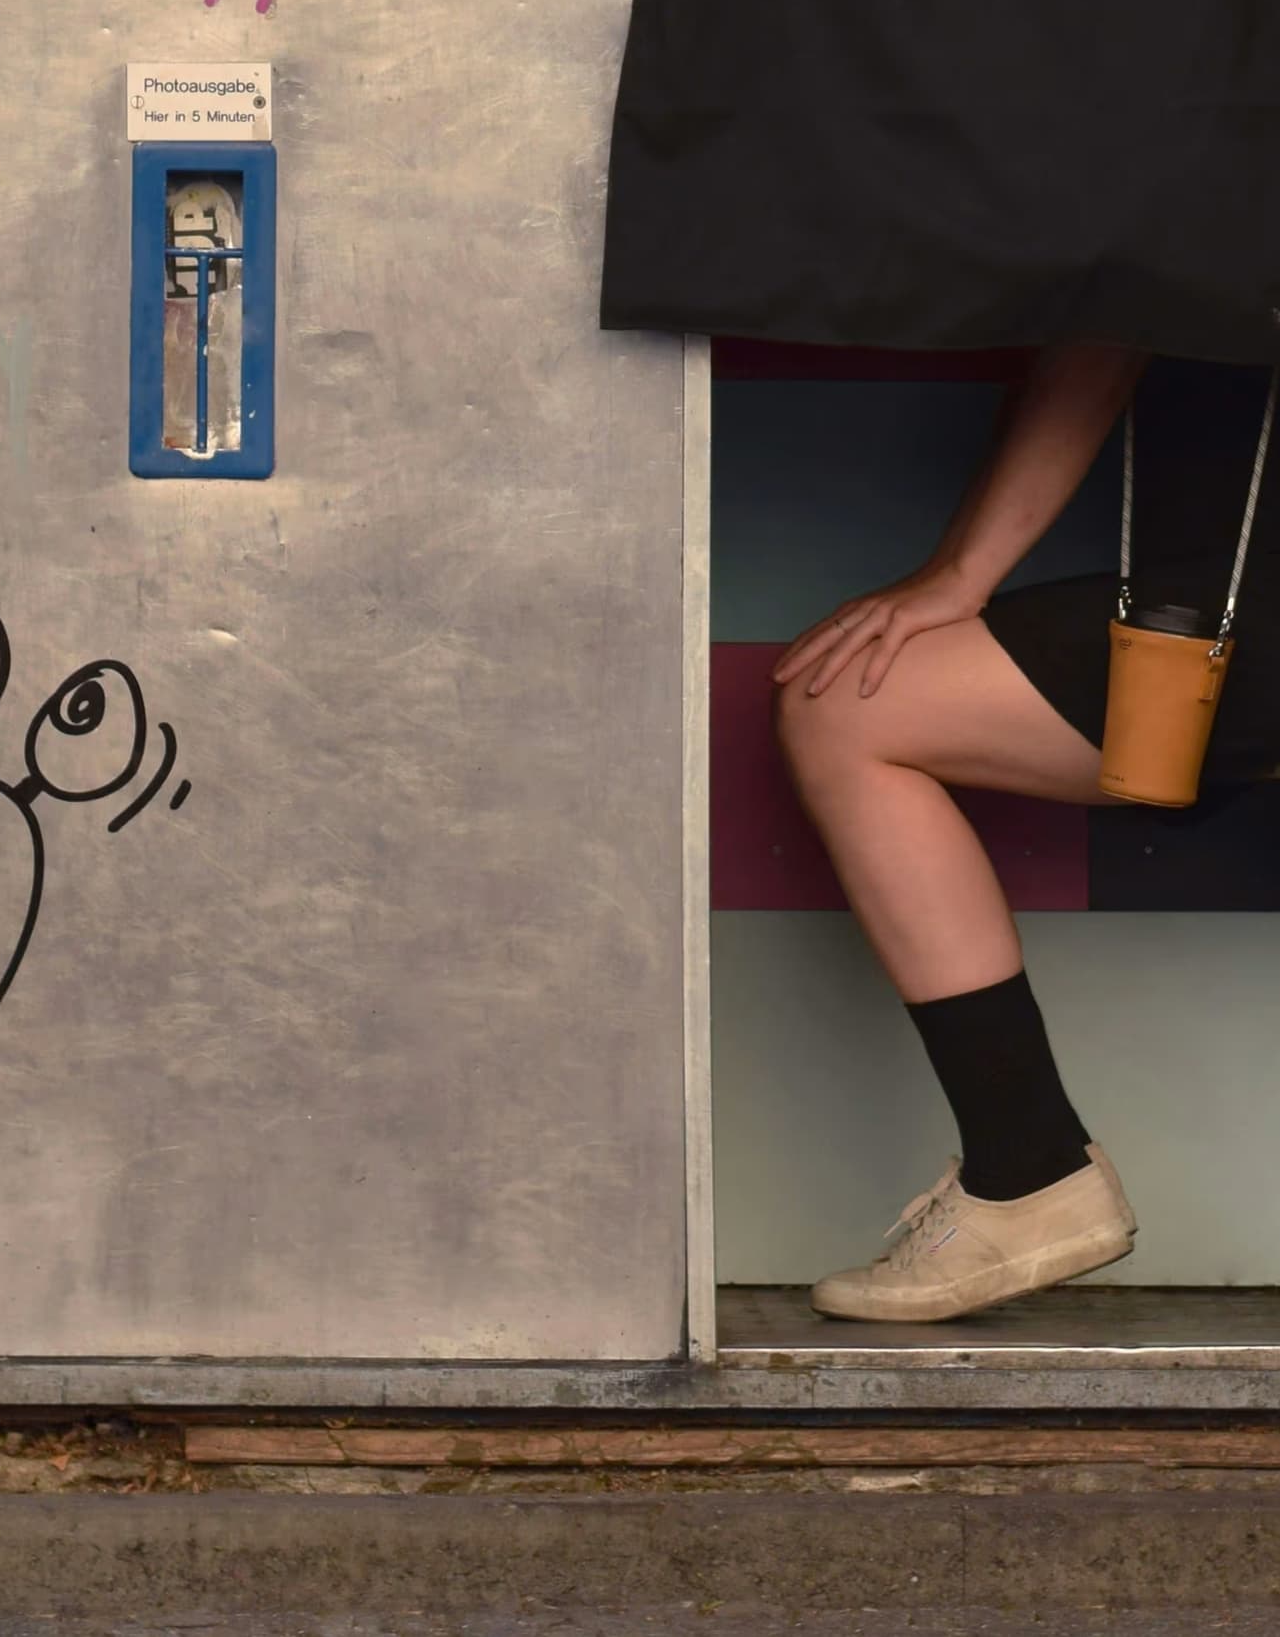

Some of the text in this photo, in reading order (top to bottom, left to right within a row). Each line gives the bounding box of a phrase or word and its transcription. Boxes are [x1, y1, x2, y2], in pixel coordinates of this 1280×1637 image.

[144, 78, 256, 96] Photoausgabe
[144, 111, 256, 123] Hier in 5 Minuten
